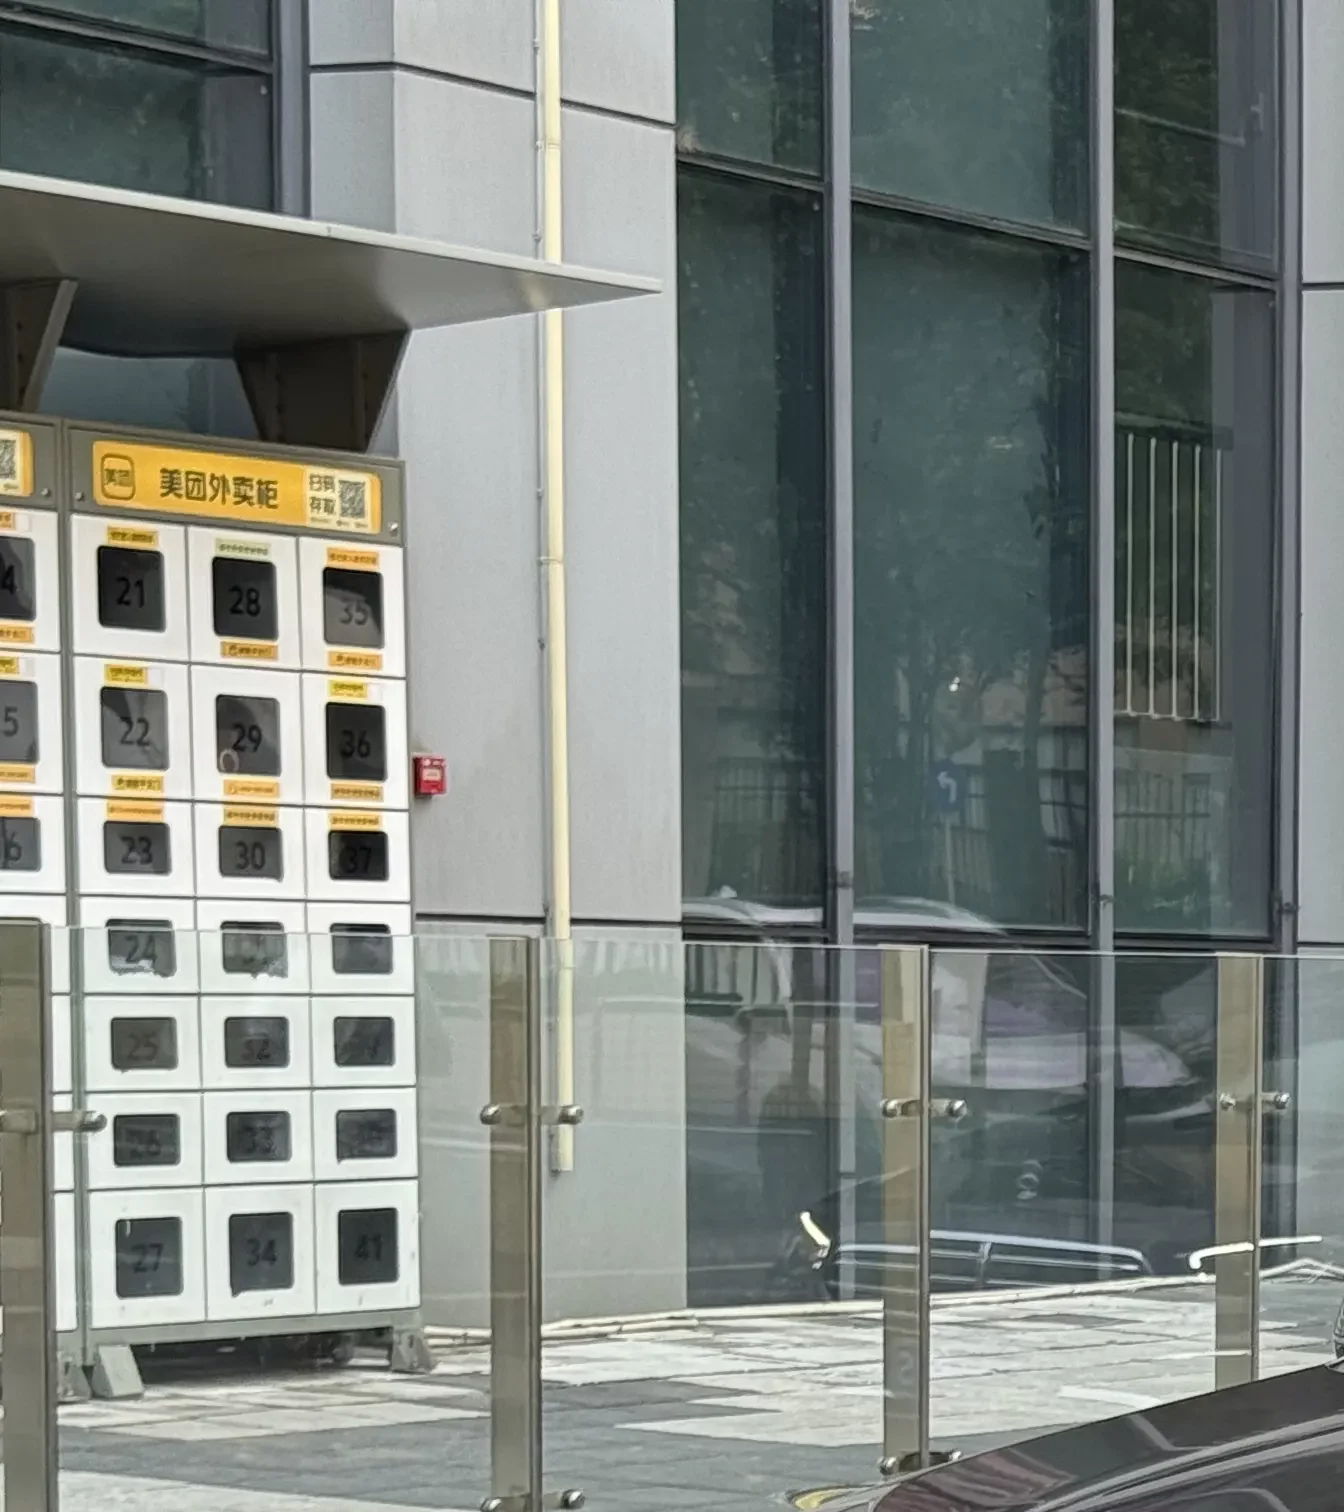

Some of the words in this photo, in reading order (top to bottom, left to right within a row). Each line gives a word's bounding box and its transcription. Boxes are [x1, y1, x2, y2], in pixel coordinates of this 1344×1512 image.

[159, 467, 279, 510] 美团外卖柜
[116, 576, 145, 609] 21
[229, 585, 261, 617] 28
[339, 597, 369, 626] 35
[120, 716, 150, 747] 22
[232, 723, 262, 753] 29
[340, 729, 371, 758] 36
[119, 835, 153, 865] 23
[235, 842, 266, 870] 30
[344, 845, 372, 873] 37
[124, 934, 156, 964] 24
[127, 1033, 157, 1060] 25
[132, 1243, 163, 1272] 27
[247, 1238, 277, 1267] 34
[356, 1233, 383, 1261] 41
